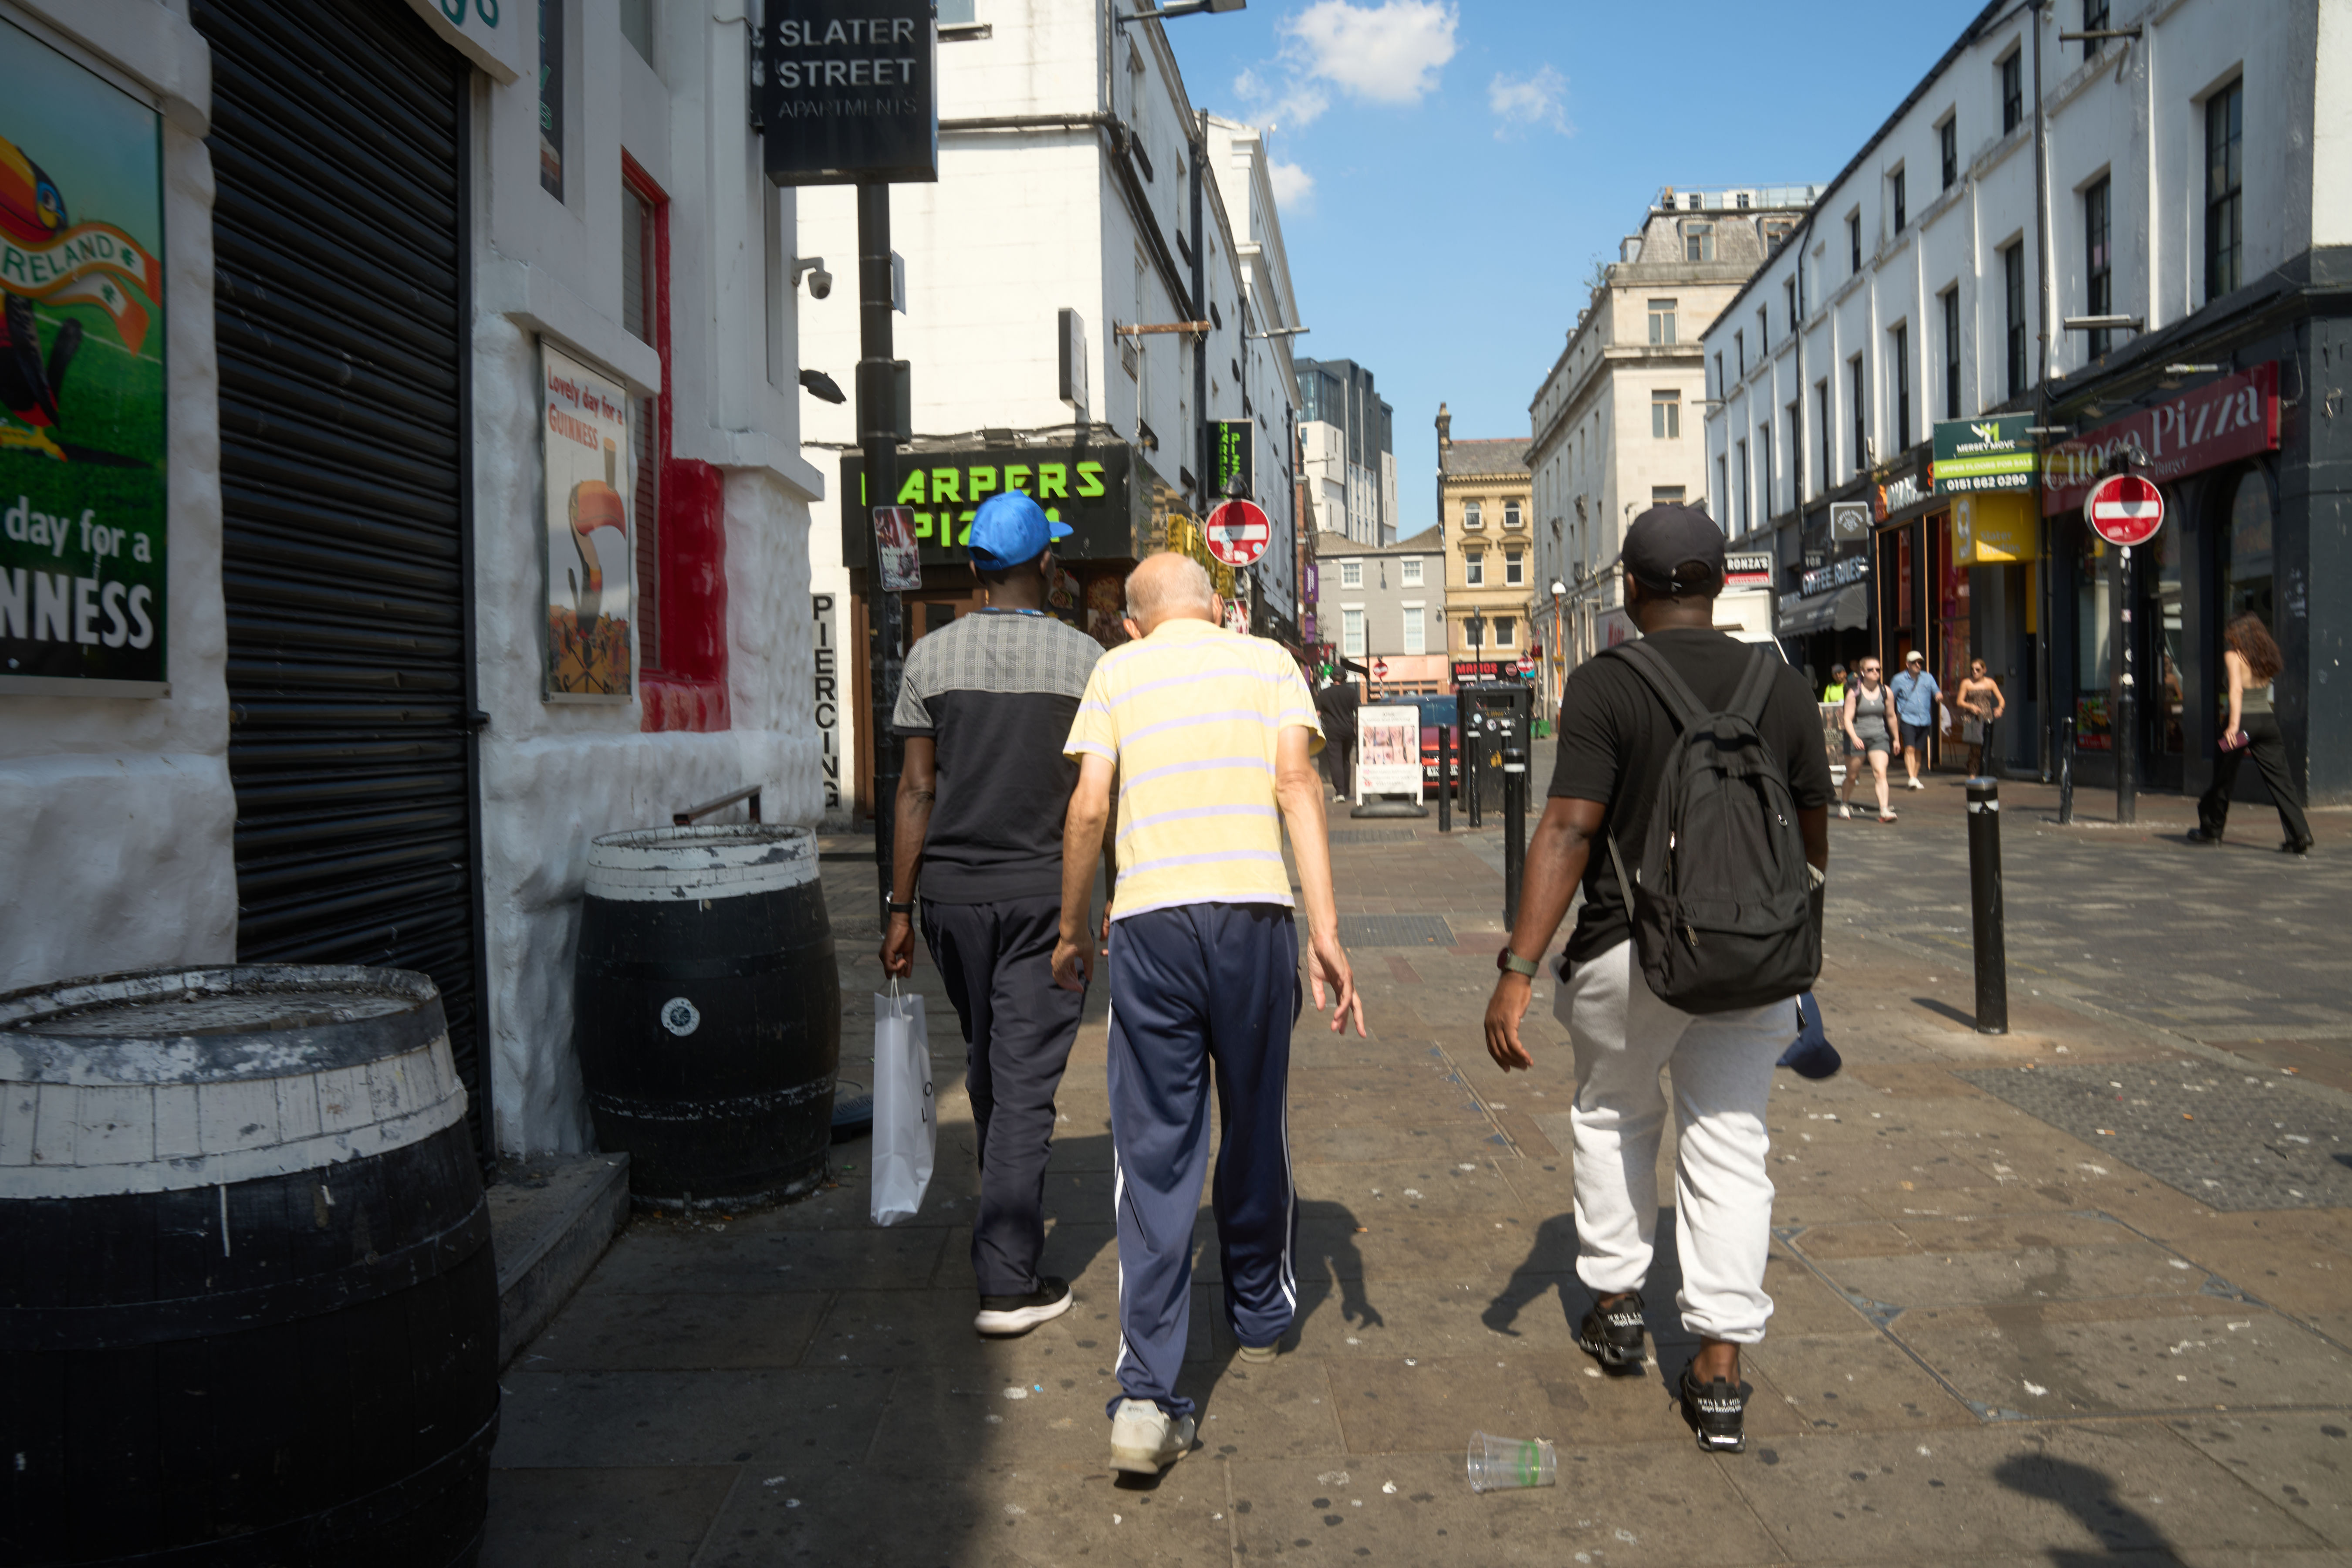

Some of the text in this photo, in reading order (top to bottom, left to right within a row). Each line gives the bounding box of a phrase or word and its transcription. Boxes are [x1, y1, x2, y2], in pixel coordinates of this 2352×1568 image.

[778, 17, 915, 47] SLATER
[778, 58, 916, 88] STREET
[547, 364, 623, 426] Lovely day for a
[547, 402, 598, 451] GUINNESS
[2150, 385, 2261, 458] Pizza
[1940, 457, 2034, 474] UPPER FLOORS FOR SALE
[1956, 441, 1989, 454] MERSEY
[1990, 439, 2015, 450] MOVE
[861, 461, 1105, 507] ARPERS
[1946, 477, 1971, 491] 0151
[5, 495, 152, 563] day for a
[1957, 499, 1971, 559] 9
[1727, 557, 1768, 571] RONZA'S
